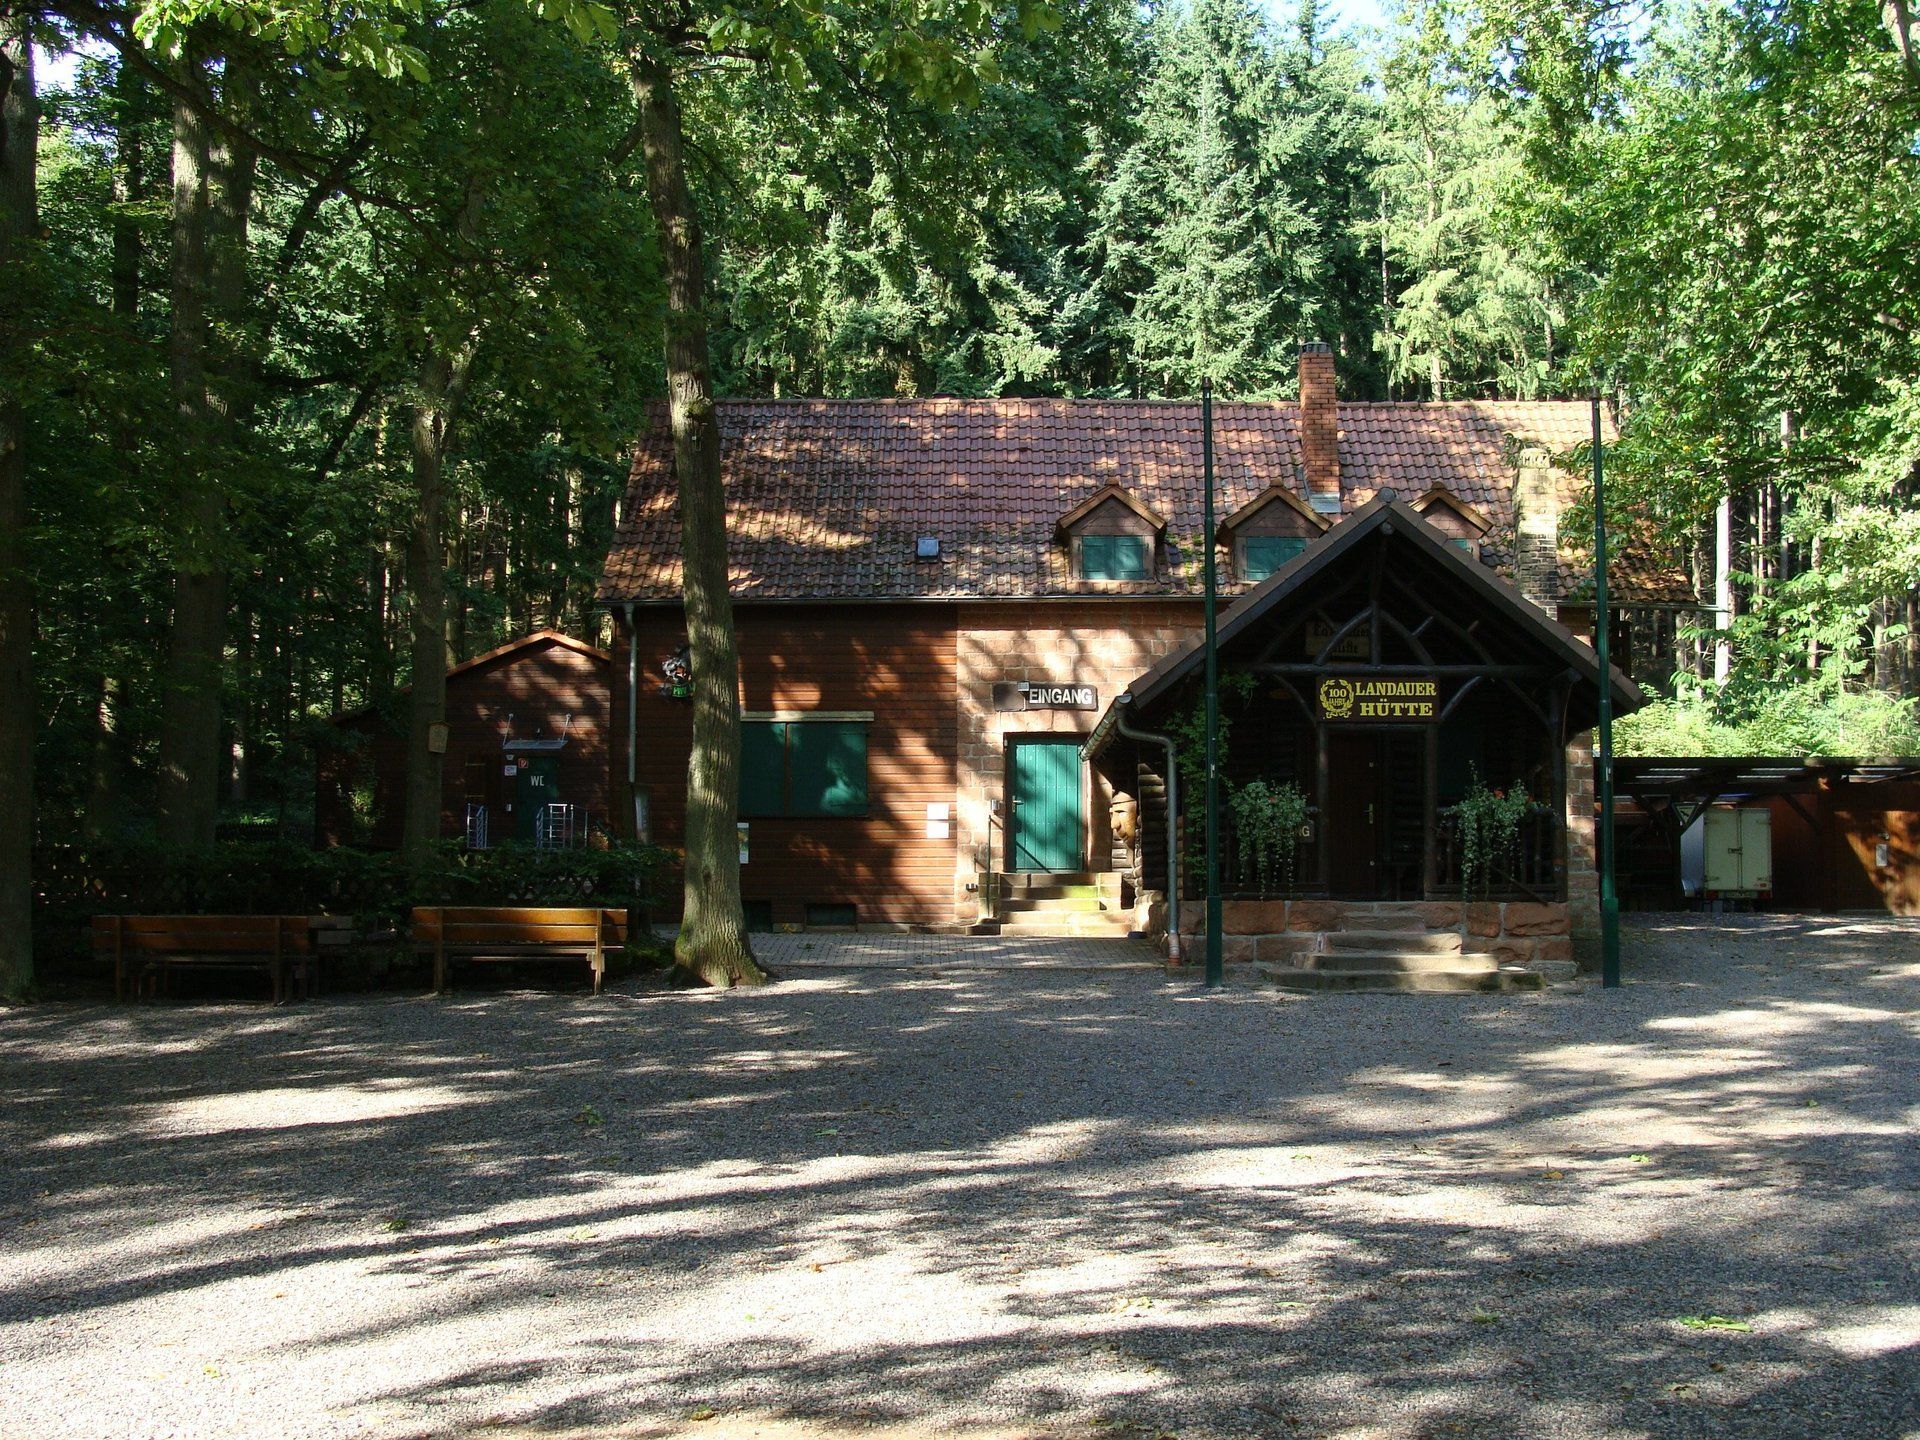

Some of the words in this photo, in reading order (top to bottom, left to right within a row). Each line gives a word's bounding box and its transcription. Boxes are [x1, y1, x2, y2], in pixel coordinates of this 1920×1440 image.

[1030, 688, 1093, 704] EINGANG
[1329, 688, 1347, 698] 100
[1355, 682, 1437, 696] LANDAUER
[1359, 697, 1433, 716] HÜTTE
[530, 775, 545, 787] WC
